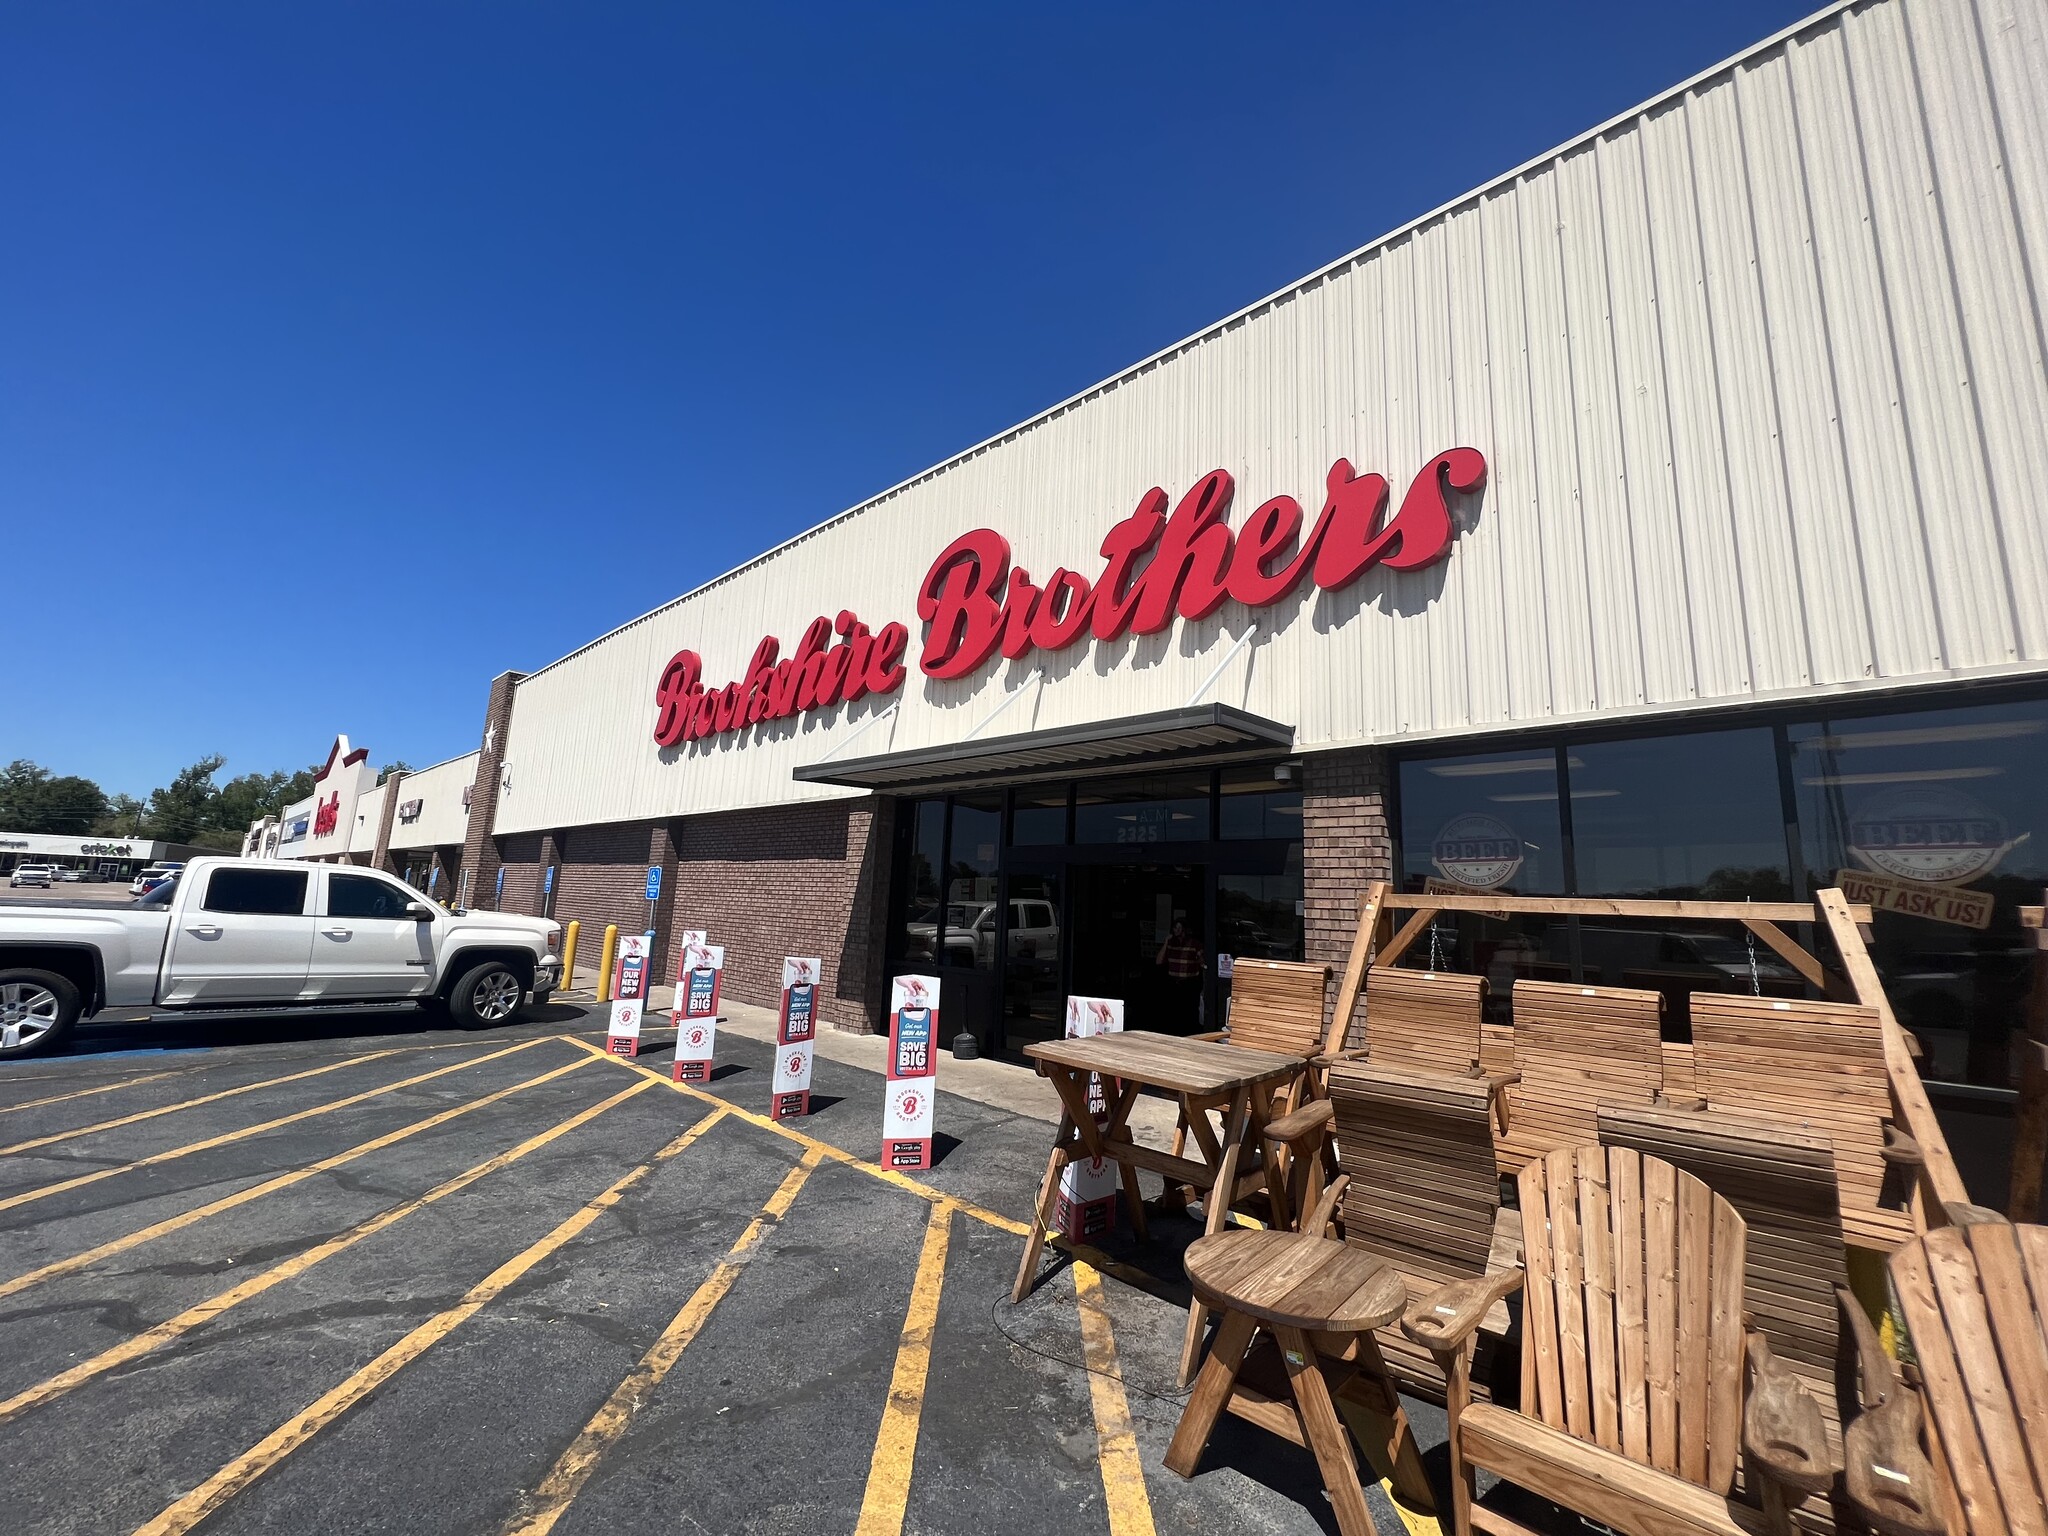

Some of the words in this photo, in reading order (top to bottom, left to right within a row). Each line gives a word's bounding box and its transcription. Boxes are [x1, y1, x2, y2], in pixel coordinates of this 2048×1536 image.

[655, 610, 908, 747] Brookshire
[917, 447, 1487, 680] Brothers
[1117, 825, 1158, 843] 2325
[1858, 823, 1984, 846] BEEF
[80, 842, 132, 857] cricket
[1440, 841, 1513, 861] BEEF
[1875, 853, 1944, 879] CERTIFIED
[1945, 852, 1987, 877] FRESH
[1447, 865, 1486, 883] CERTIFIED
[1487, 863, 1510, 882] FRESH
[1894, 891, 1941, 916] ASK
[1946, 901, 1985, 925] US!
[623, 971, 639, 979] OUR
[622, 978, 639, 987] NEW
[690, 999, 710, 1010] BIG
[622, 1010, 631, 1022] B
[790, 1012, 809, 1020] SAVE
[789, 1020, 809, 1032] BIG
[691, 1030, 702, 1044] B
[900, 1042, 926, 1051] SAVE
[790, 1056, 800, 1073] B
[899, 1051, 926, 1067] BIG
[895, 1089, 926, 1102] BROOKSHIRE
[1089, 1084, 1103, 1098] NE
[903, 1096, 917, 1114] B
[896, 1111, 924, 1122] BROTHERS
